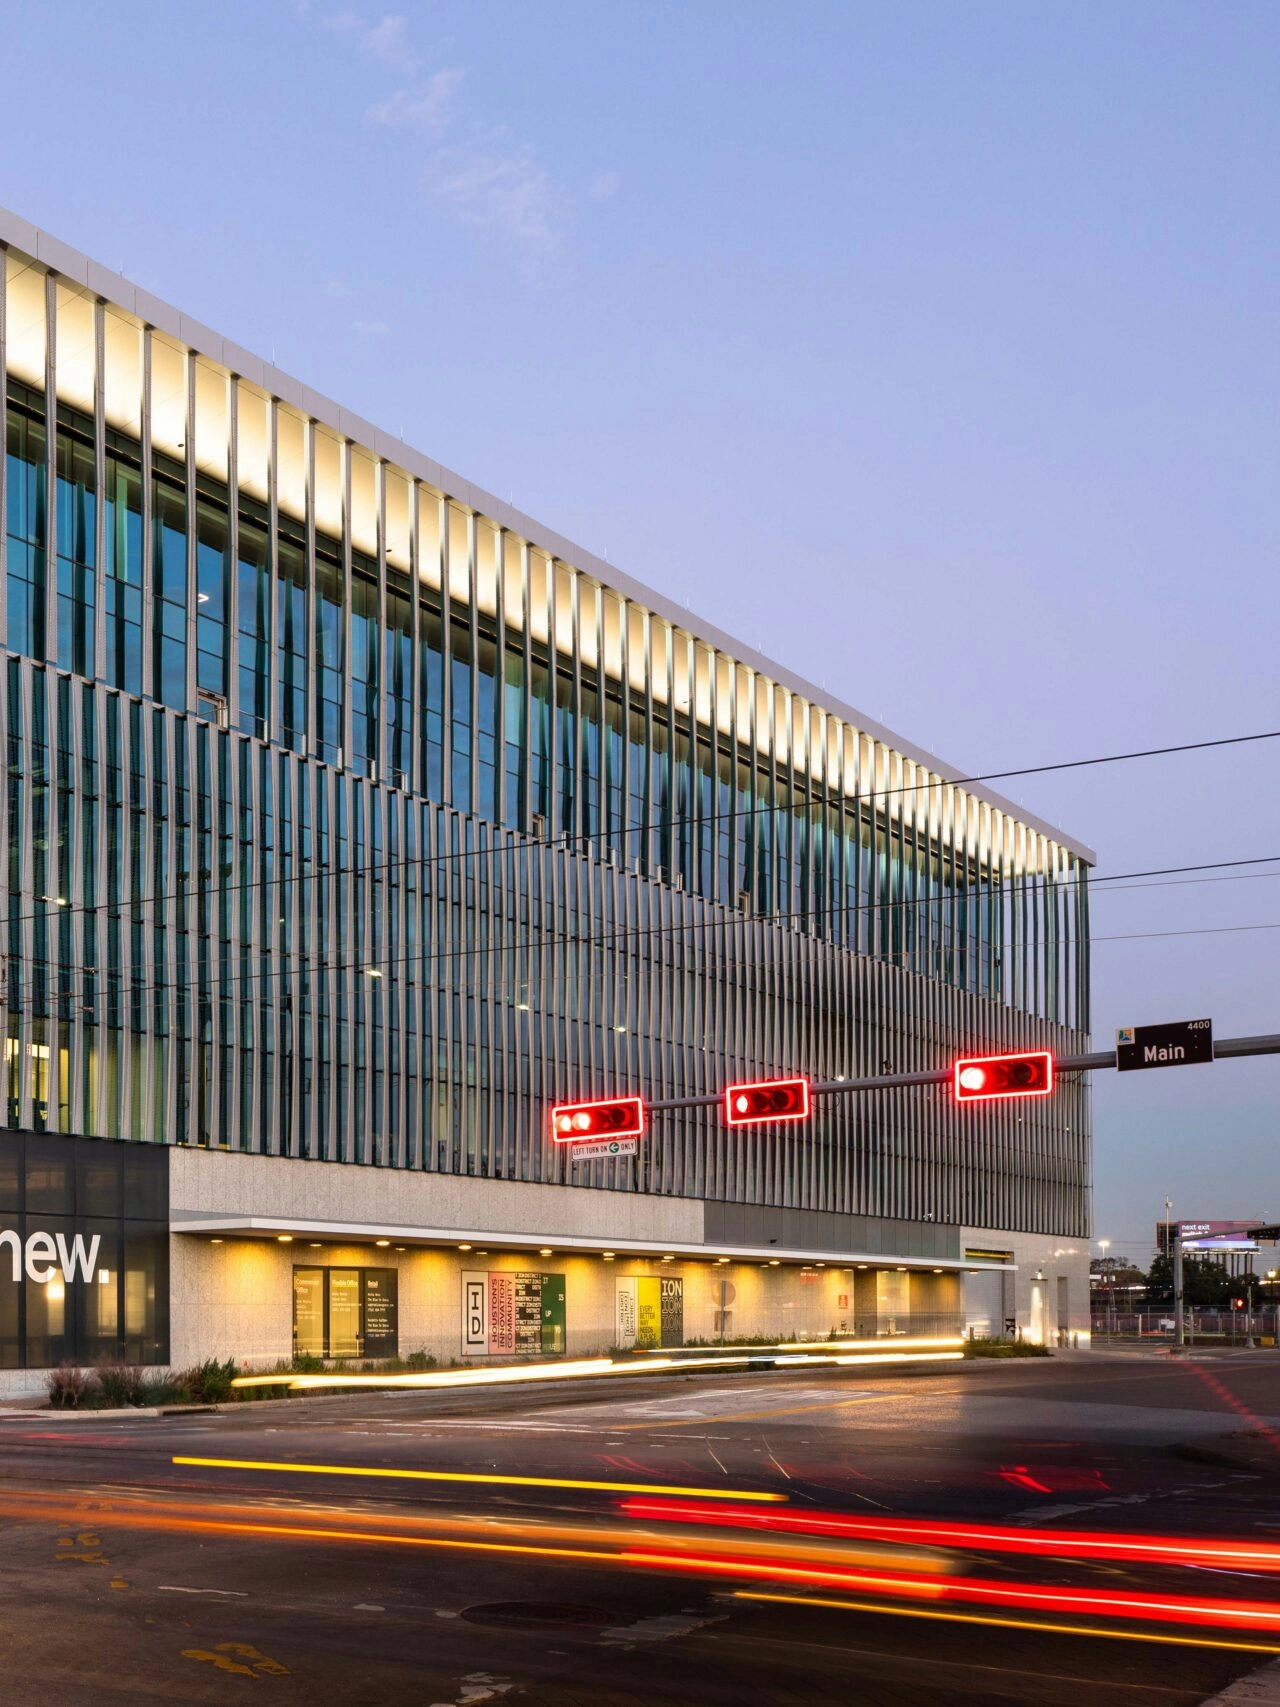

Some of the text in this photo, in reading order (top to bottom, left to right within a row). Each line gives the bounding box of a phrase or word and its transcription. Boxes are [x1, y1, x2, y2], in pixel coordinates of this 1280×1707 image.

[1187, 1020, 1210, 1031] 4400
[1144, 1043, 1185, 1063] Main
[573, 1142, 634, 1156] LEFT TURN ON ONLY
[1198, 1223, 1210, 1231] exit
[662, 1280, 682, 1296] ION
[639, 1305, 653, 1313] EVERY
[662, 1297, 682, 1314] ION
[639, 1319, 649, 1327] WAY
